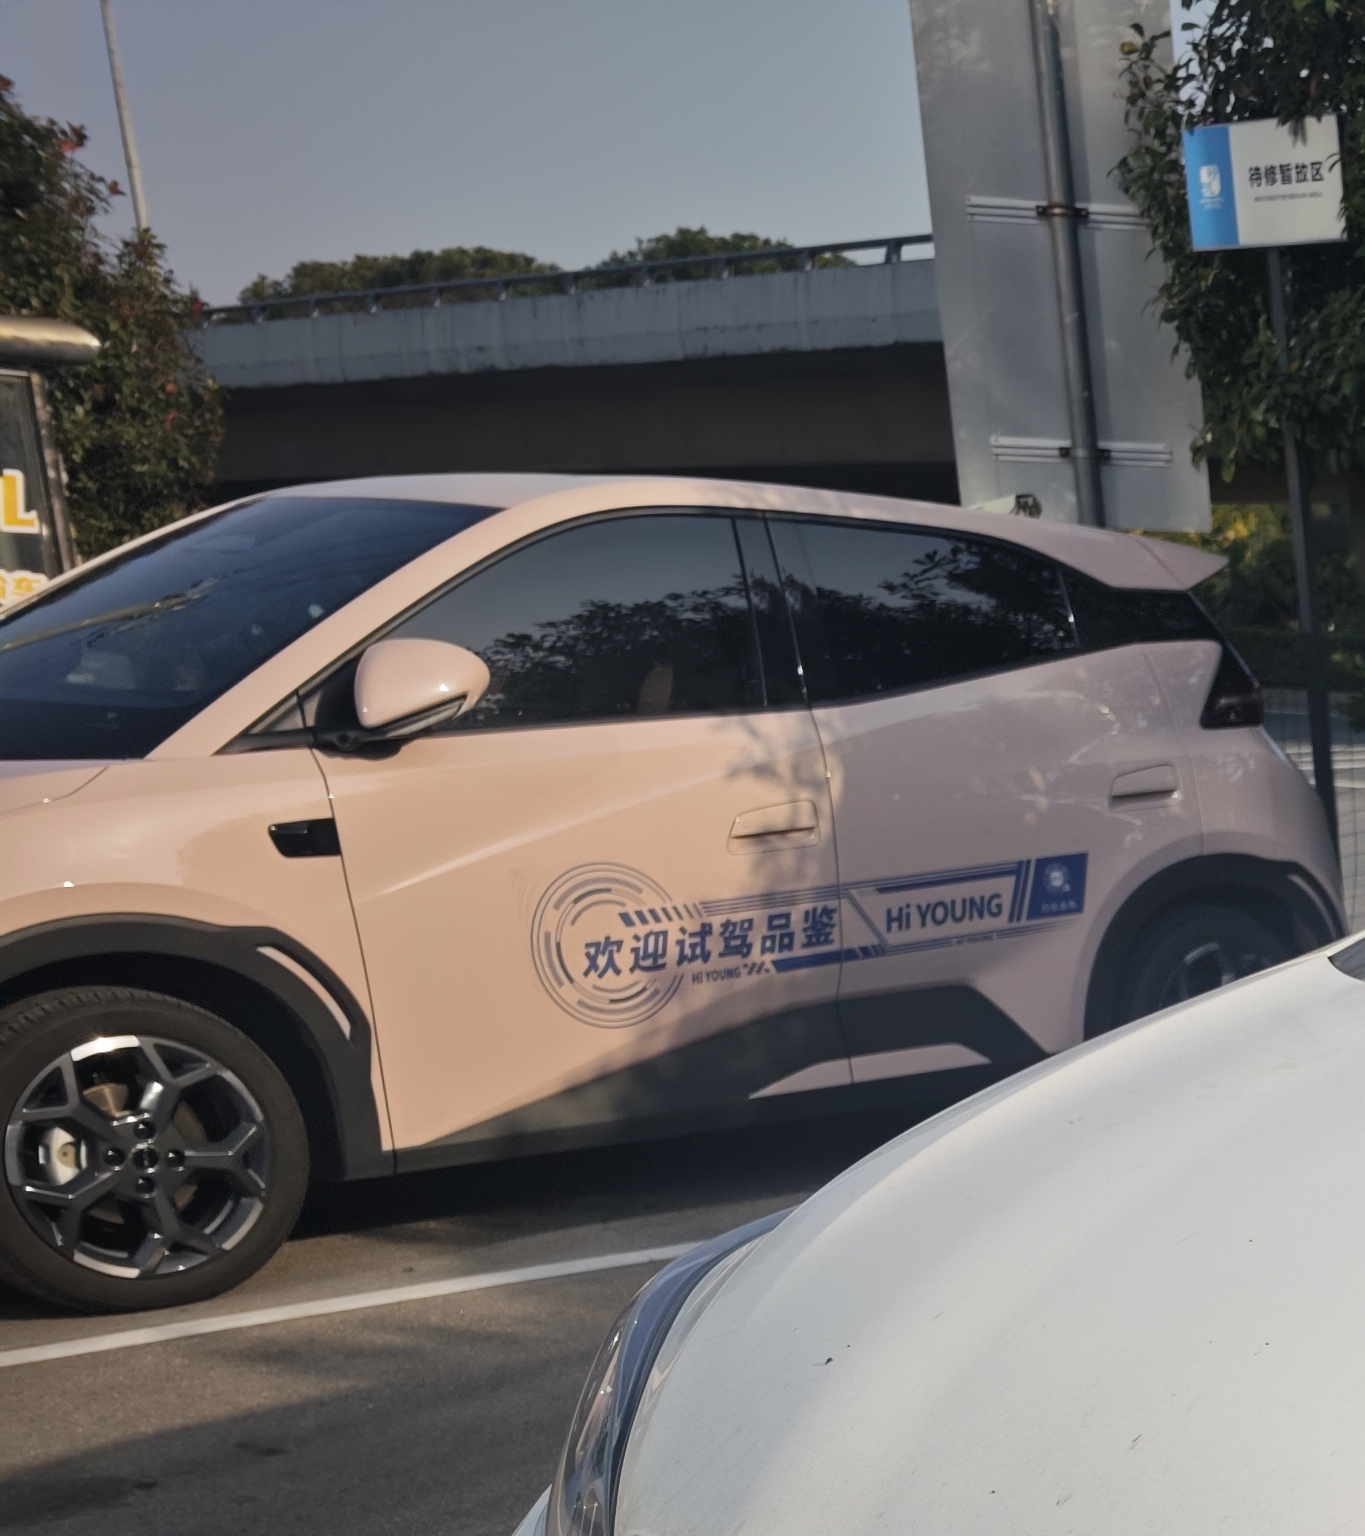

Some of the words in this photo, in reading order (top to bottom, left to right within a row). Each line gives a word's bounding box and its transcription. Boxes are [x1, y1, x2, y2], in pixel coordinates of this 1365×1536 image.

[1248, 162, 1325, 188] 待修暂放区
[886, 903, 911, 933] Hi
[916, 892, 1003, 929] YOUNG
[583, 904, 838, 979] 欢迎试驾品鉴
[705, 967, 742, 983] YOUNG
